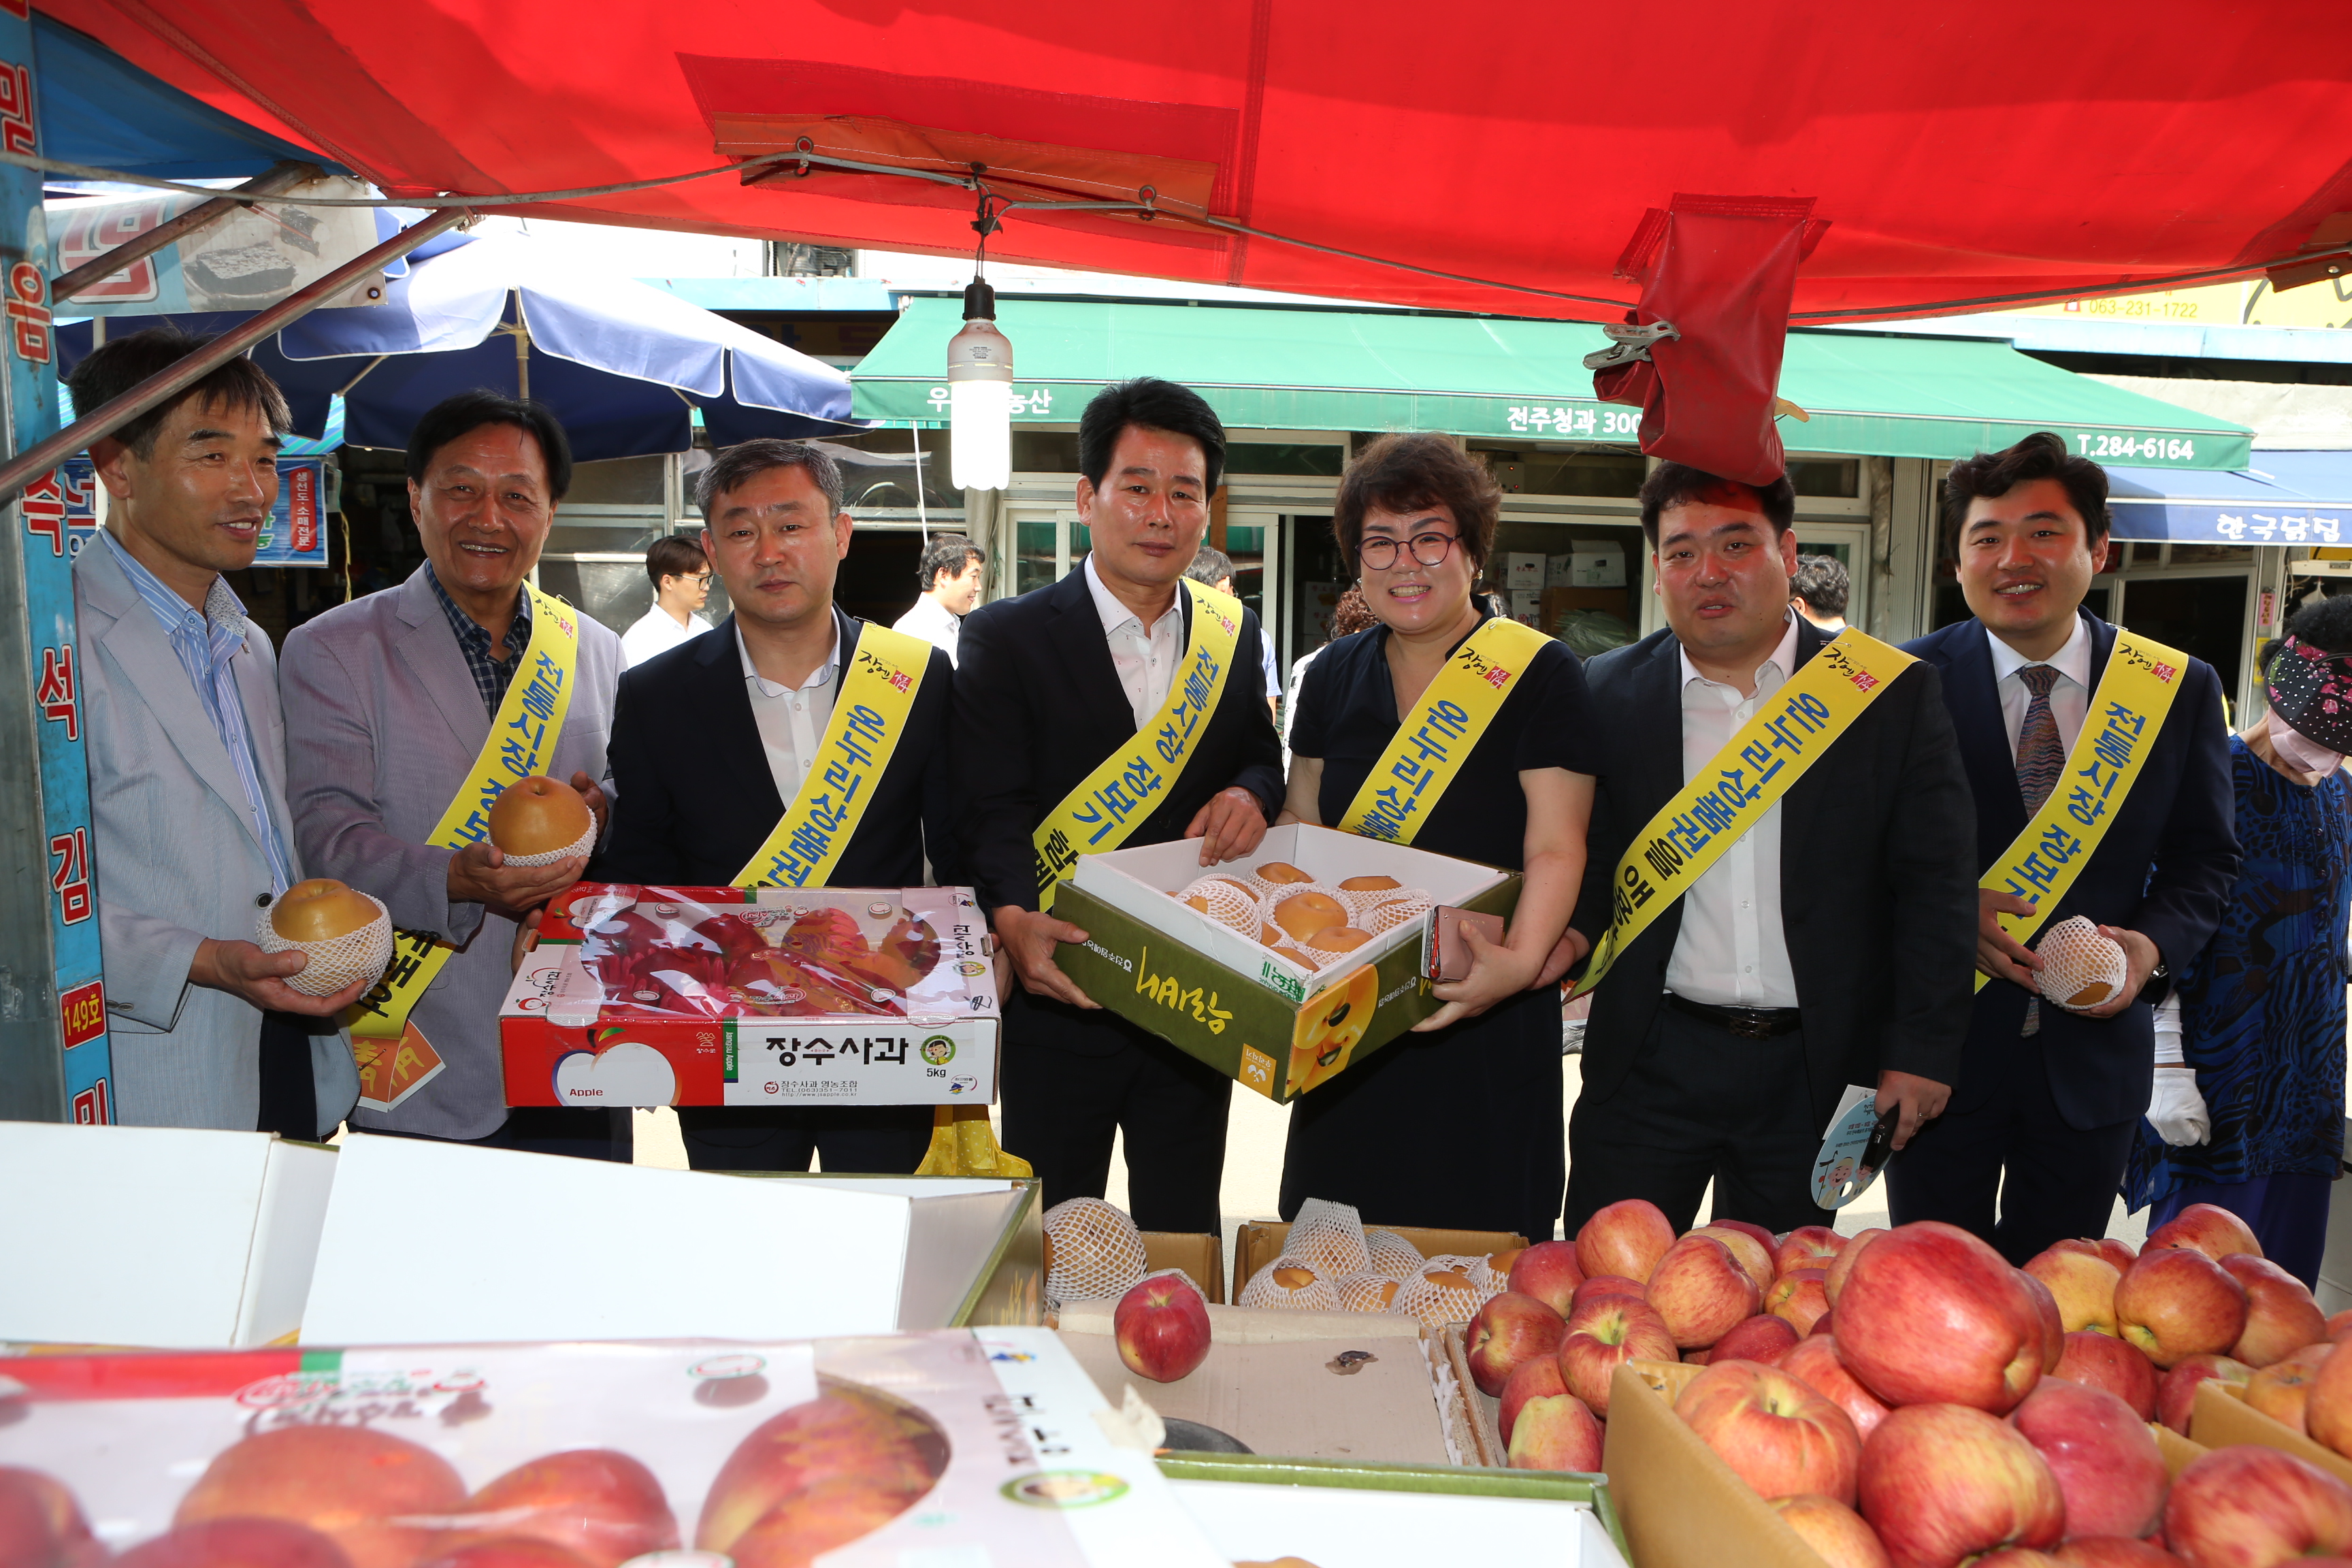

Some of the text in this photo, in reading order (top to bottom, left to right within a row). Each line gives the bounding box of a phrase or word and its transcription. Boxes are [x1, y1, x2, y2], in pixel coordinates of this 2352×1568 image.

[2089, 299, 2198, 318] 063-231-1722
[1507, 406, 1597, 434] 전주청과
[2077, 434, 2194, 460] T.284-6164
[2217, 514, 2340, 542] 한국닭집
[500, 650, 564, 779] 전통시장
[1156, 644, 1220, 764] 전통시장
[2067, 701, 2146, 827] 전통시장
[748, 704, 885, 887] 온누리상품권
[1072, 755, 1162, 846] 장보기
[1082, 939, 1124, 966] 전주원예농
[64, 994, 102, 1036] 149호
[725, 1032, 734, 1071] Jangsu Apple
[766, 1037, 909, 1067] 장수사과
[781, 1080, 818, 1088] 장수사과
[926, 1068, 947, 1078] 5kg
[570, 1088, 604, 1097] Apple
